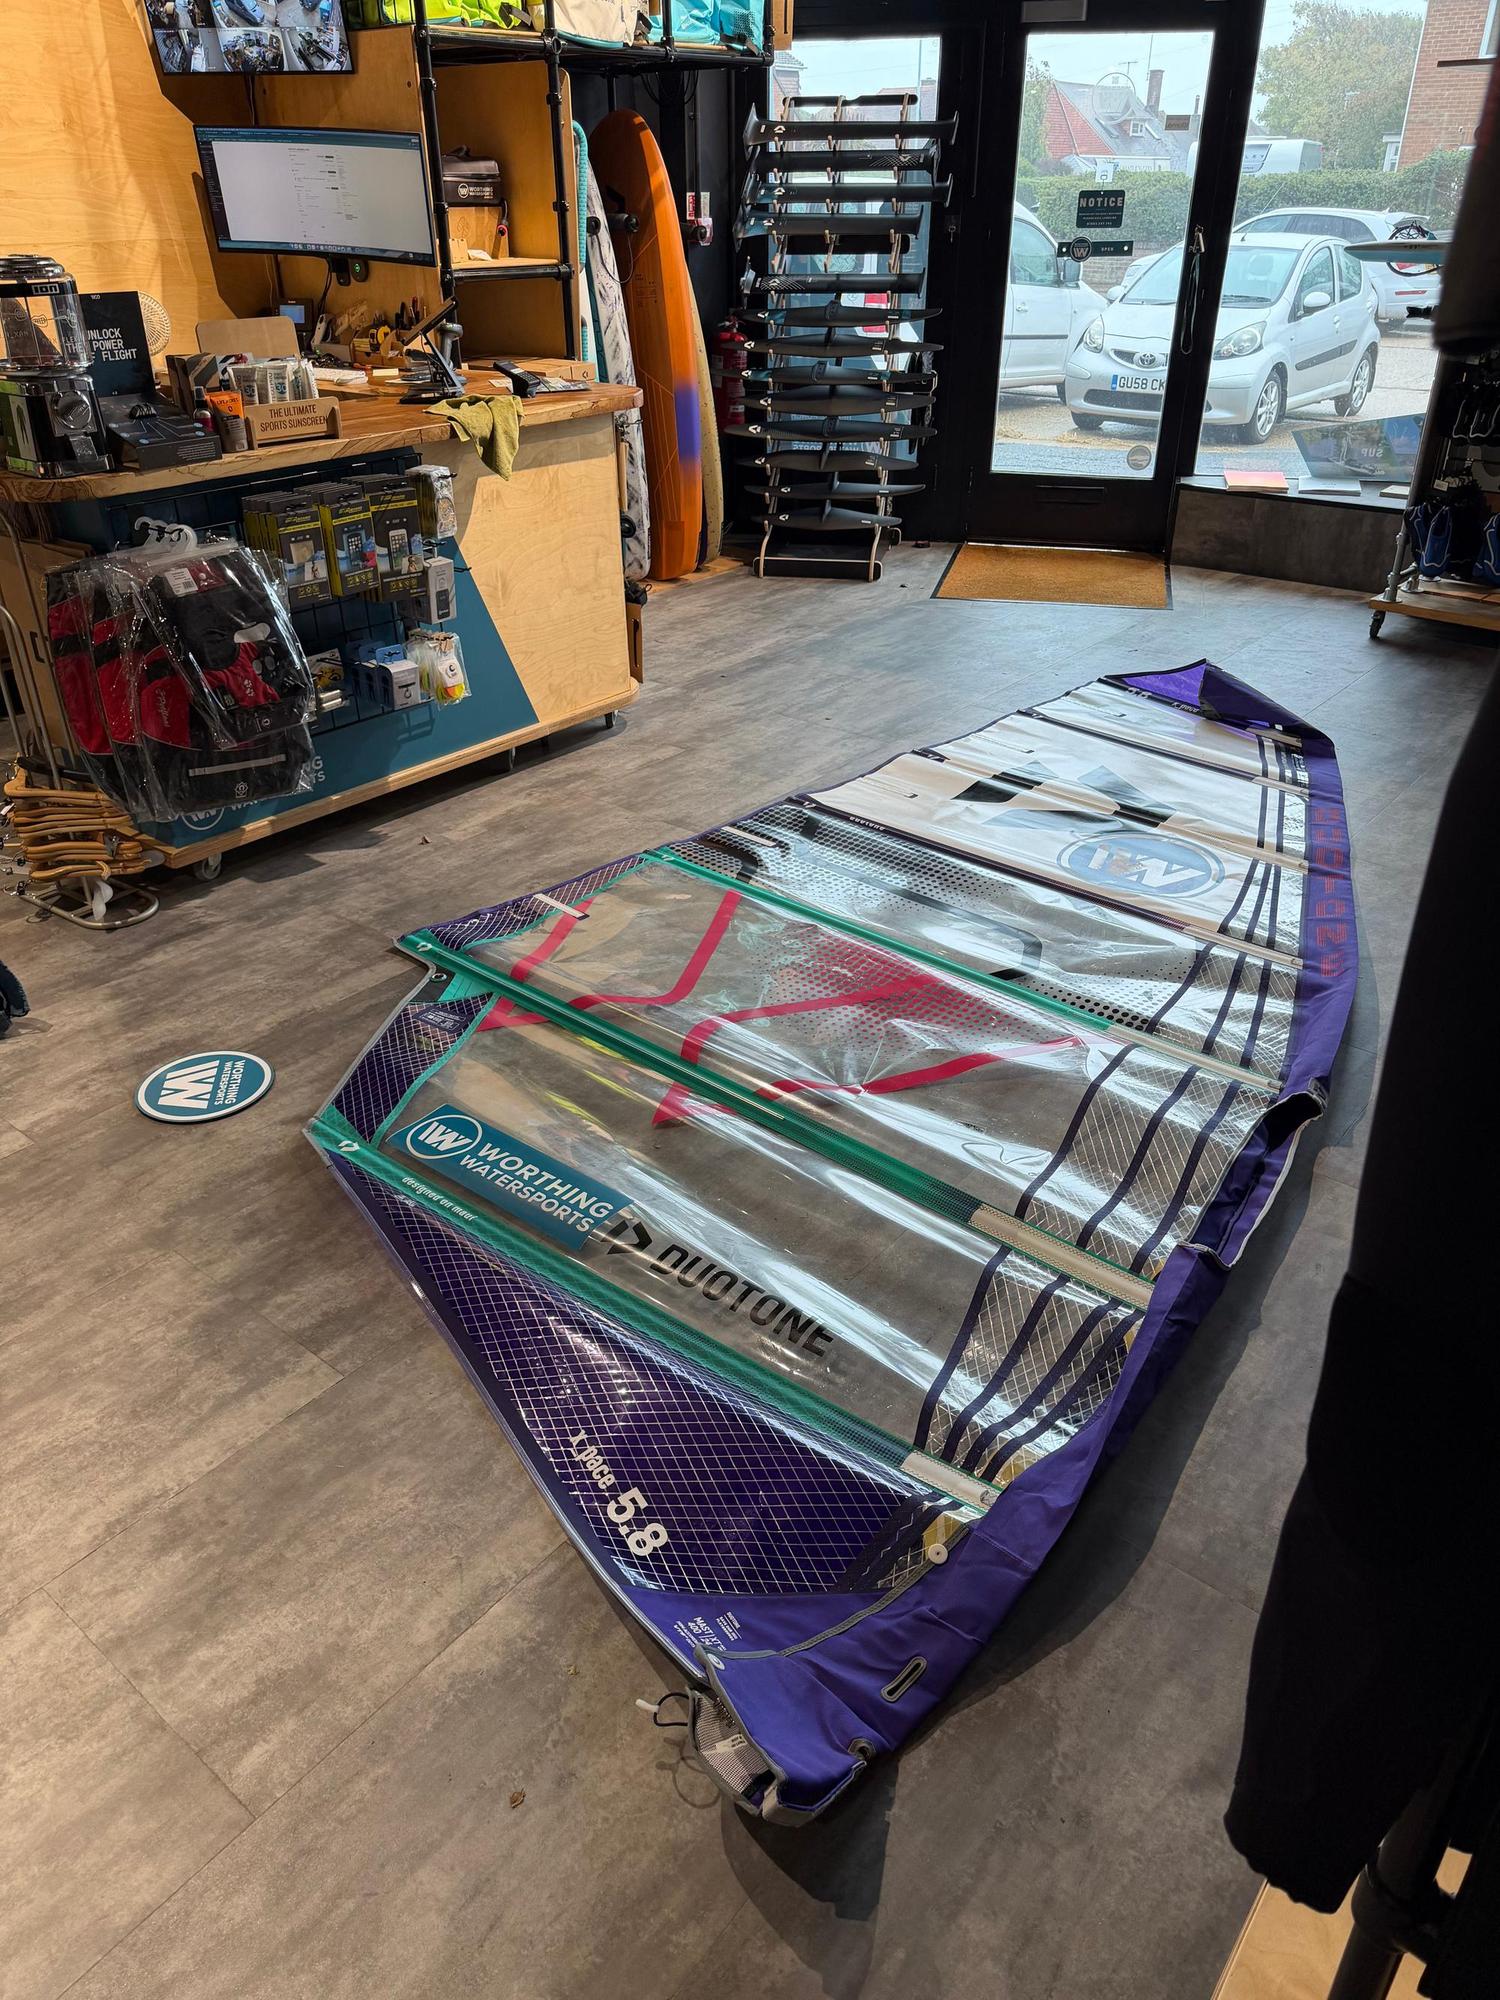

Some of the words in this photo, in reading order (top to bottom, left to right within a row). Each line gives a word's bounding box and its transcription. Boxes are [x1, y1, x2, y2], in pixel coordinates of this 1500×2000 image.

[1080, 197, 1123, 207] NOTICE
[93, 340, 124, 351] POWER
[102, 349, 137, 362] FLIGHT
[1119, 376, 1148, 390] GU58
[260, 418, 287, 432] SPORTS
[288, 415, 328, 428] SUNSCREEN
[269, 409, 283, 418] THE
[284, 404, 316, 417] ULTIMATE
[214, 1060, 234, 1106] WATERSPORTS
[224, 1059, 246, 1105] WORTHING
[459, 1154, 595, 1233] WATERSPORTS
[478, 1142, 613, 1218] WORTHING
[402, 1176, 441, 1201] designed
[439, 1198, 452, 1210] on
[452, 1203, 479, 1222] maui
[650, 1243, 834, 1358] DUOTONE
[607, 1486, 668, 1557] 5.8
[688, 1621, 702, 1635] 400
